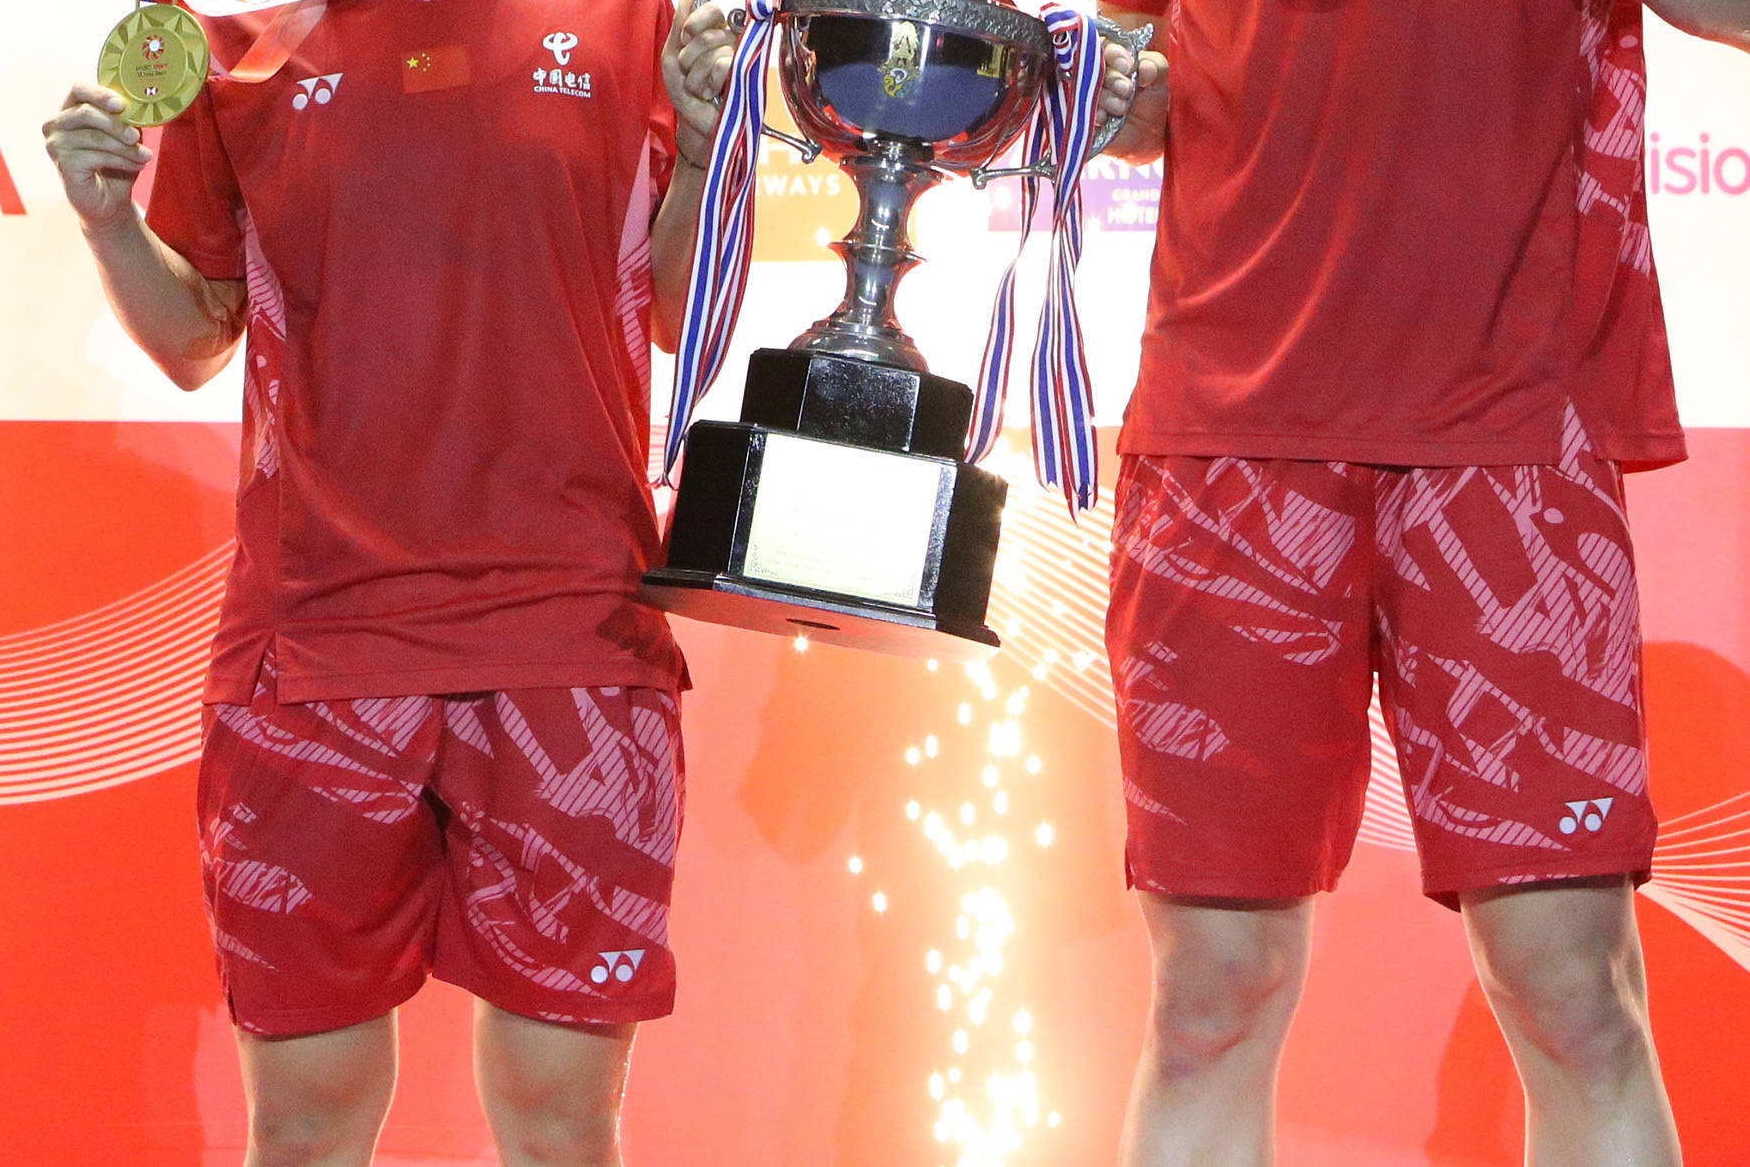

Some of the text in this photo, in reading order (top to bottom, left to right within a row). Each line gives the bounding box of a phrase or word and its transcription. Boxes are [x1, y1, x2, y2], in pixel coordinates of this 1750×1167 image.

[532, 67, 591, 90] 中国电信
[533, 85, 591, 98] CHINA TELECOM
[756, 173, 842, 197] WAYS
